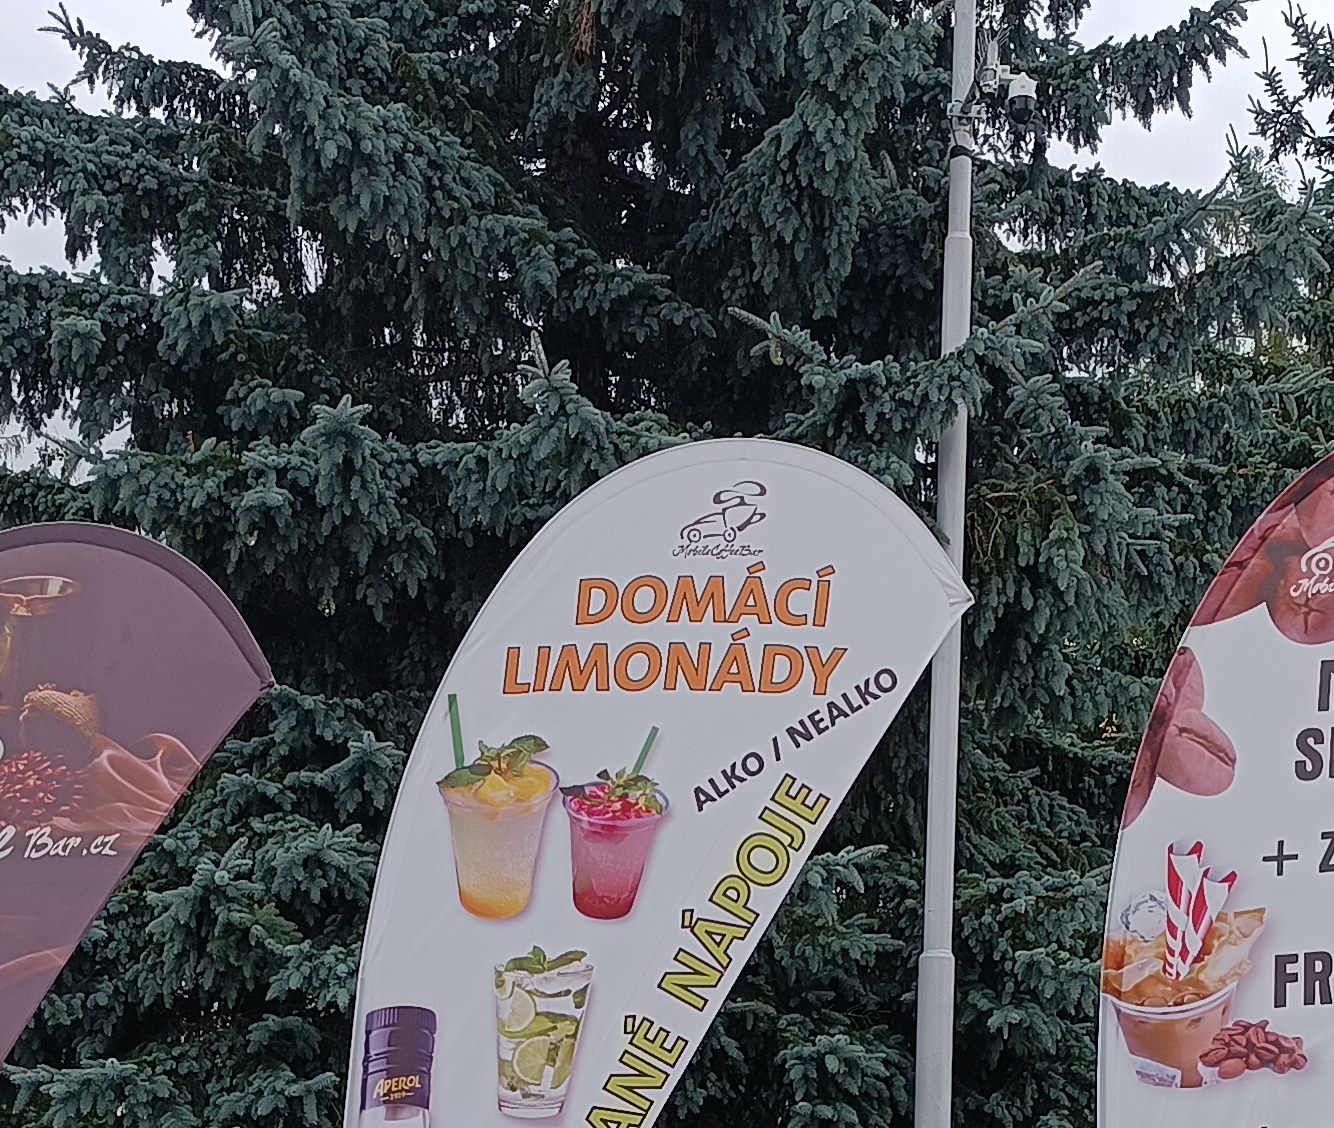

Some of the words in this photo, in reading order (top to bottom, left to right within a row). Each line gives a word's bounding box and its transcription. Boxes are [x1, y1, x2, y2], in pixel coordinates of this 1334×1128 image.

[575, 562, 835, 629] DOMÁCÍ
[501, 629, 850, 697] LIMONÁDY
[692, 750, 765, 813] ALKO
[784, 667, 899, 751] NEALKO
[24, 828, 121, 861] Bar.cz
[659, 776, 830, 1010] NÁPOJE
[373, 1075, 421, 1099] APEROL
